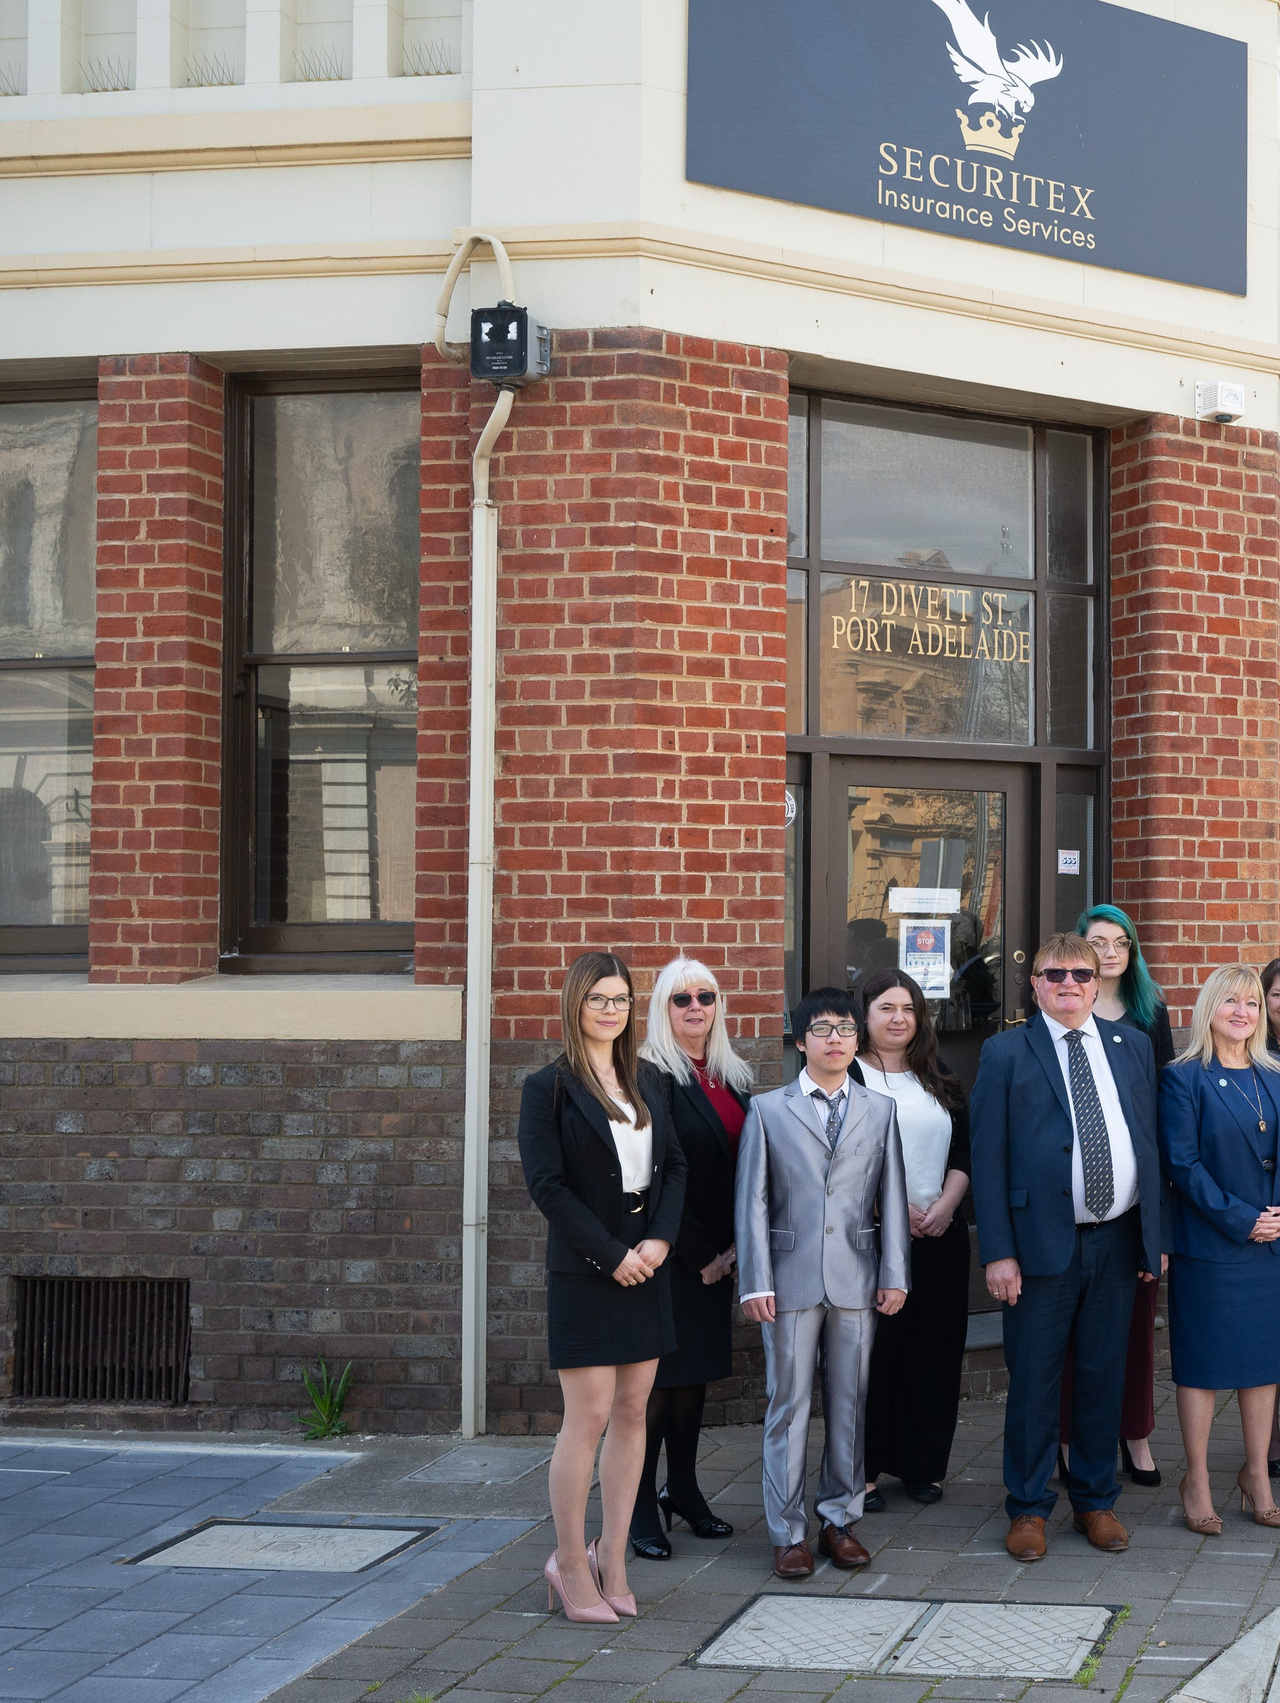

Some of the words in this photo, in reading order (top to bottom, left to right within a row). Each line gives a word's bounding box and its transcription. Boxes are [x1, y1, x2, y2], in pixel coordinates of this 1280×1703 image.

[878, 142, 1096, 220] SECURITEX
[877, 180, 993, 228] Insurance
[1002, 207, 1096, 249] Services
[850, 579, 870, 613] 17
[881, 582, 971, 622] DIVETT
[981, 591, 1013, 627] ST.
[831, 615, 896, 653] PORT
[907, 622, 1031, 663] ADELAIDE
